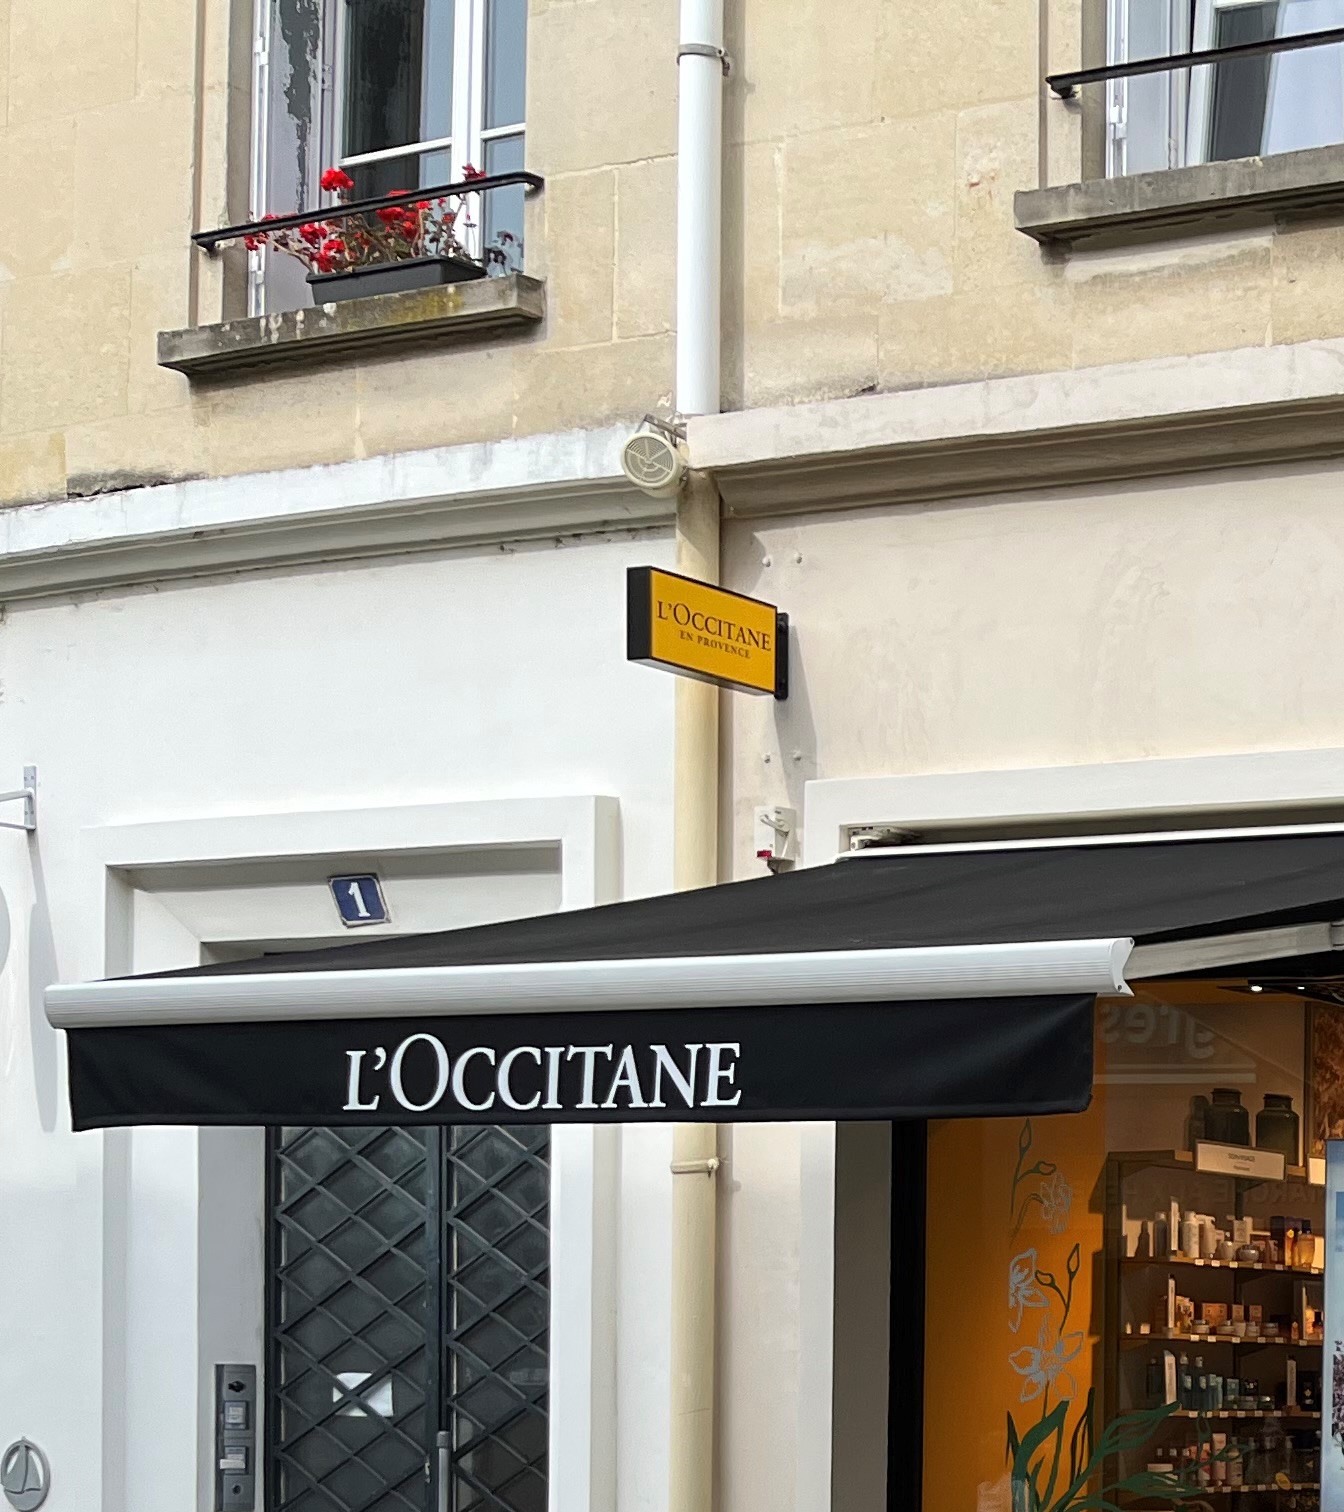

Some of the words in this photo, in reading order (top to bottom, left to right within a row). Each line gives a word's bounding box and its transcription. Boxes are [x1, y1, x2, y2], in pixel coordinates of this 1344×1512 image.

[656, 600, 772, 652] L'OCCITANE
[680, 630, 694, 642] EN
[697, 635, 752, 659] PROVENCE
[348, 881, 371, 918] 1
[342, 1032, 742, 1111] L'OCCITANE
